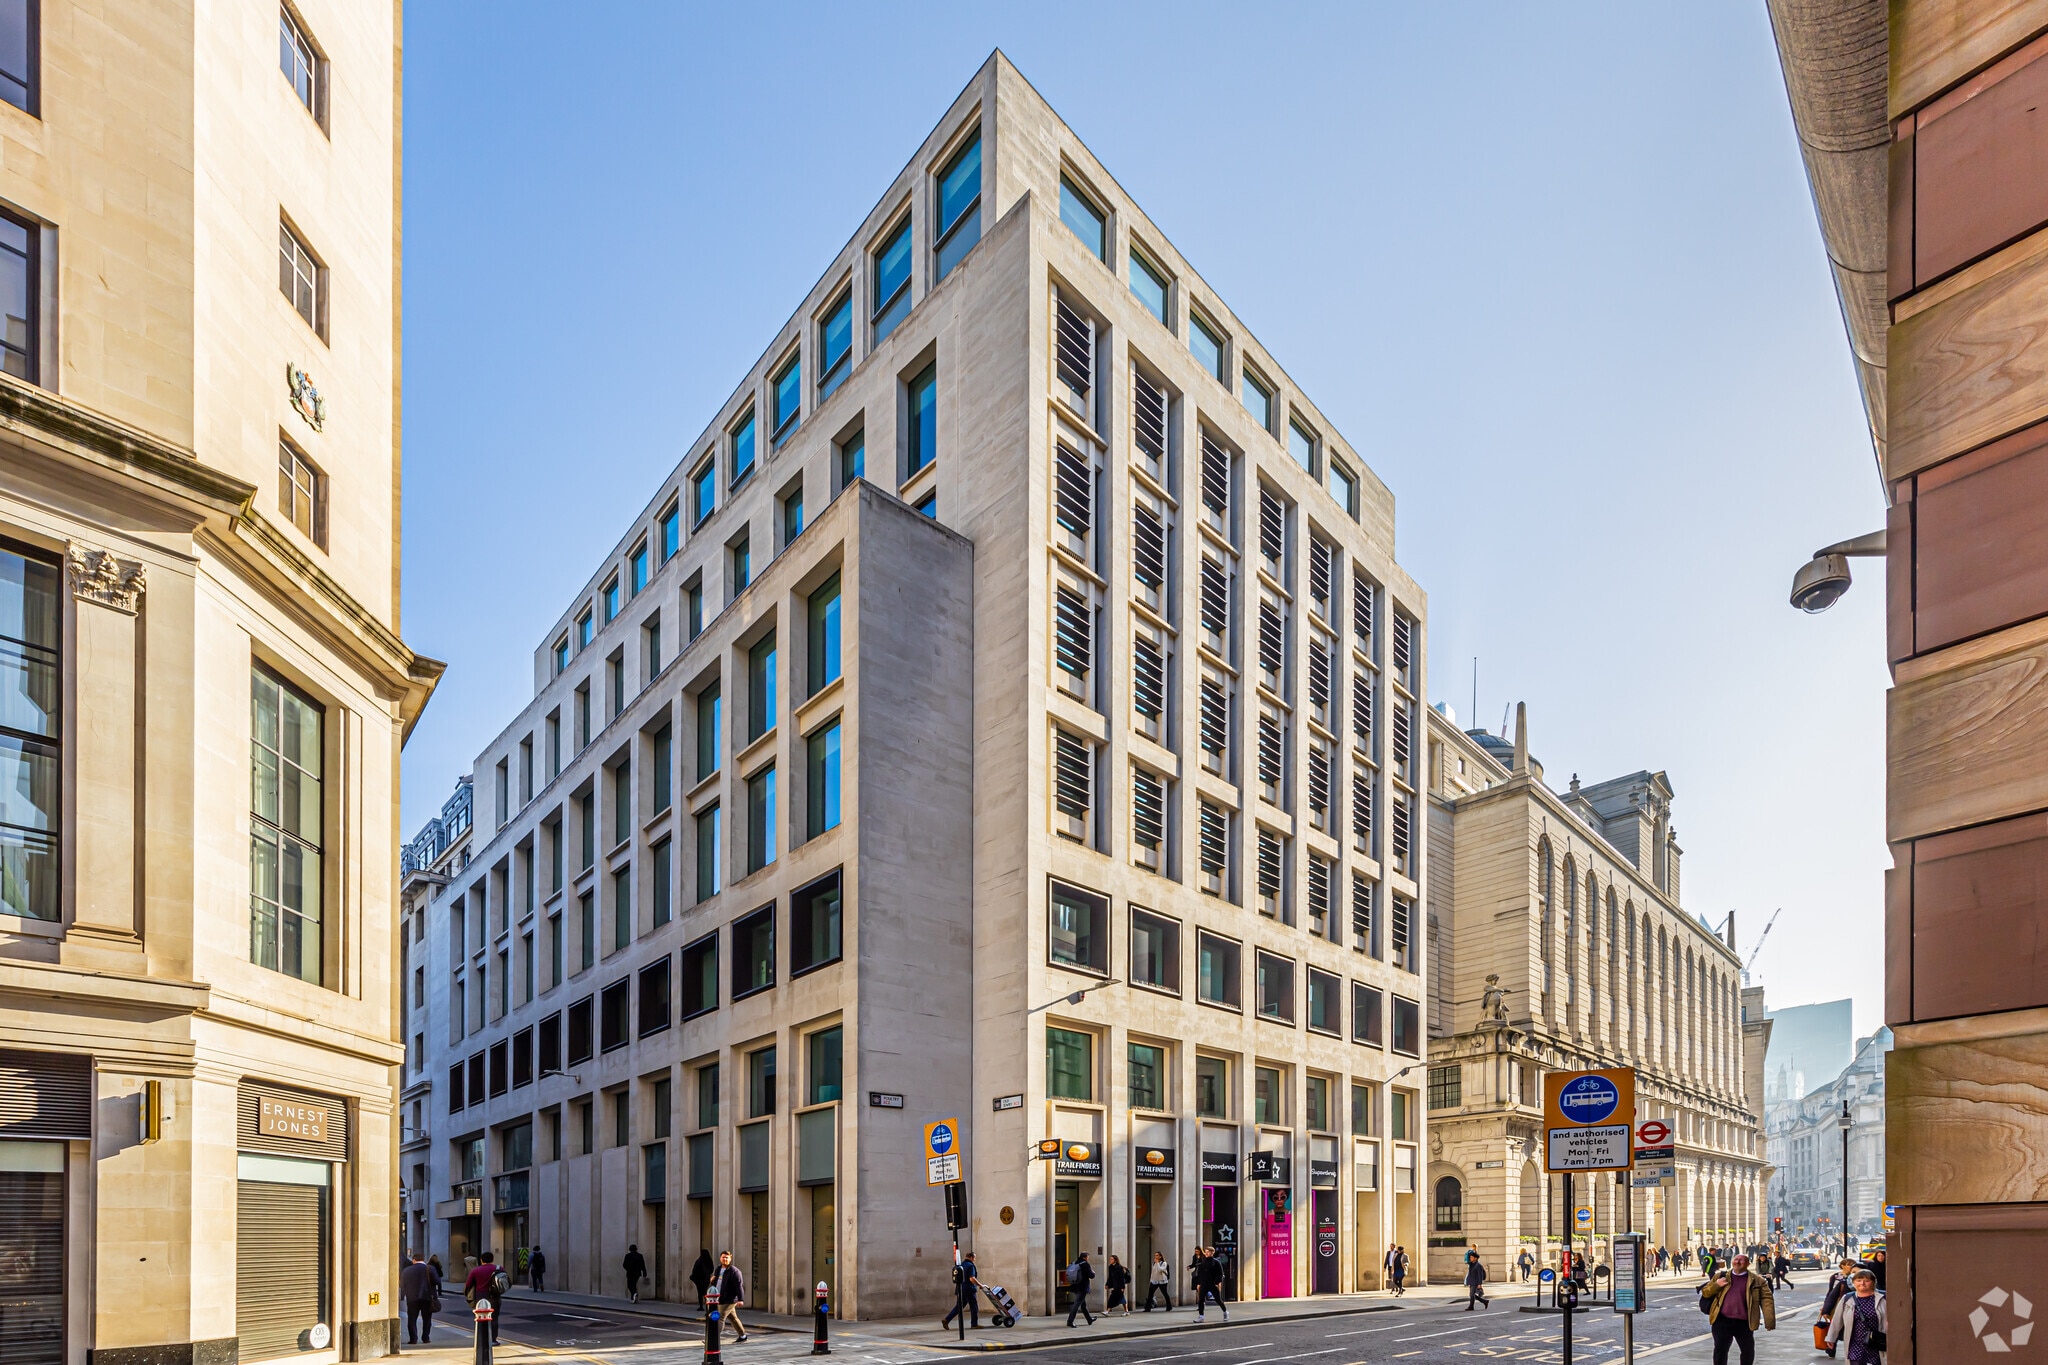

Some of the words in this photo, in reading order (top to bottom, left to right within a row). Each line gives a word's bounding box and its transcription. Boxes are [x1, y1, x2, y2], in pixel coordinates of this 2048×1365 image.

[263, 1102, 325, 1122] ERNEST
[269, 1119, 320, 1137] JONES
[1573, 1128, 1625, 1138] authorised
[1569, 1138, 1608, 1146] vehicles
[1596, 1147, 1609, 1155] Fri
[1057, 1161, 1100, 1170] TRAILFINDERS
[1137, 1165, 1173, 1173] TRAILFINDERS
[1202, 1161, 1236, 1172] Superdrug
[1310, 1168, 1337, 1178] Superdrug
